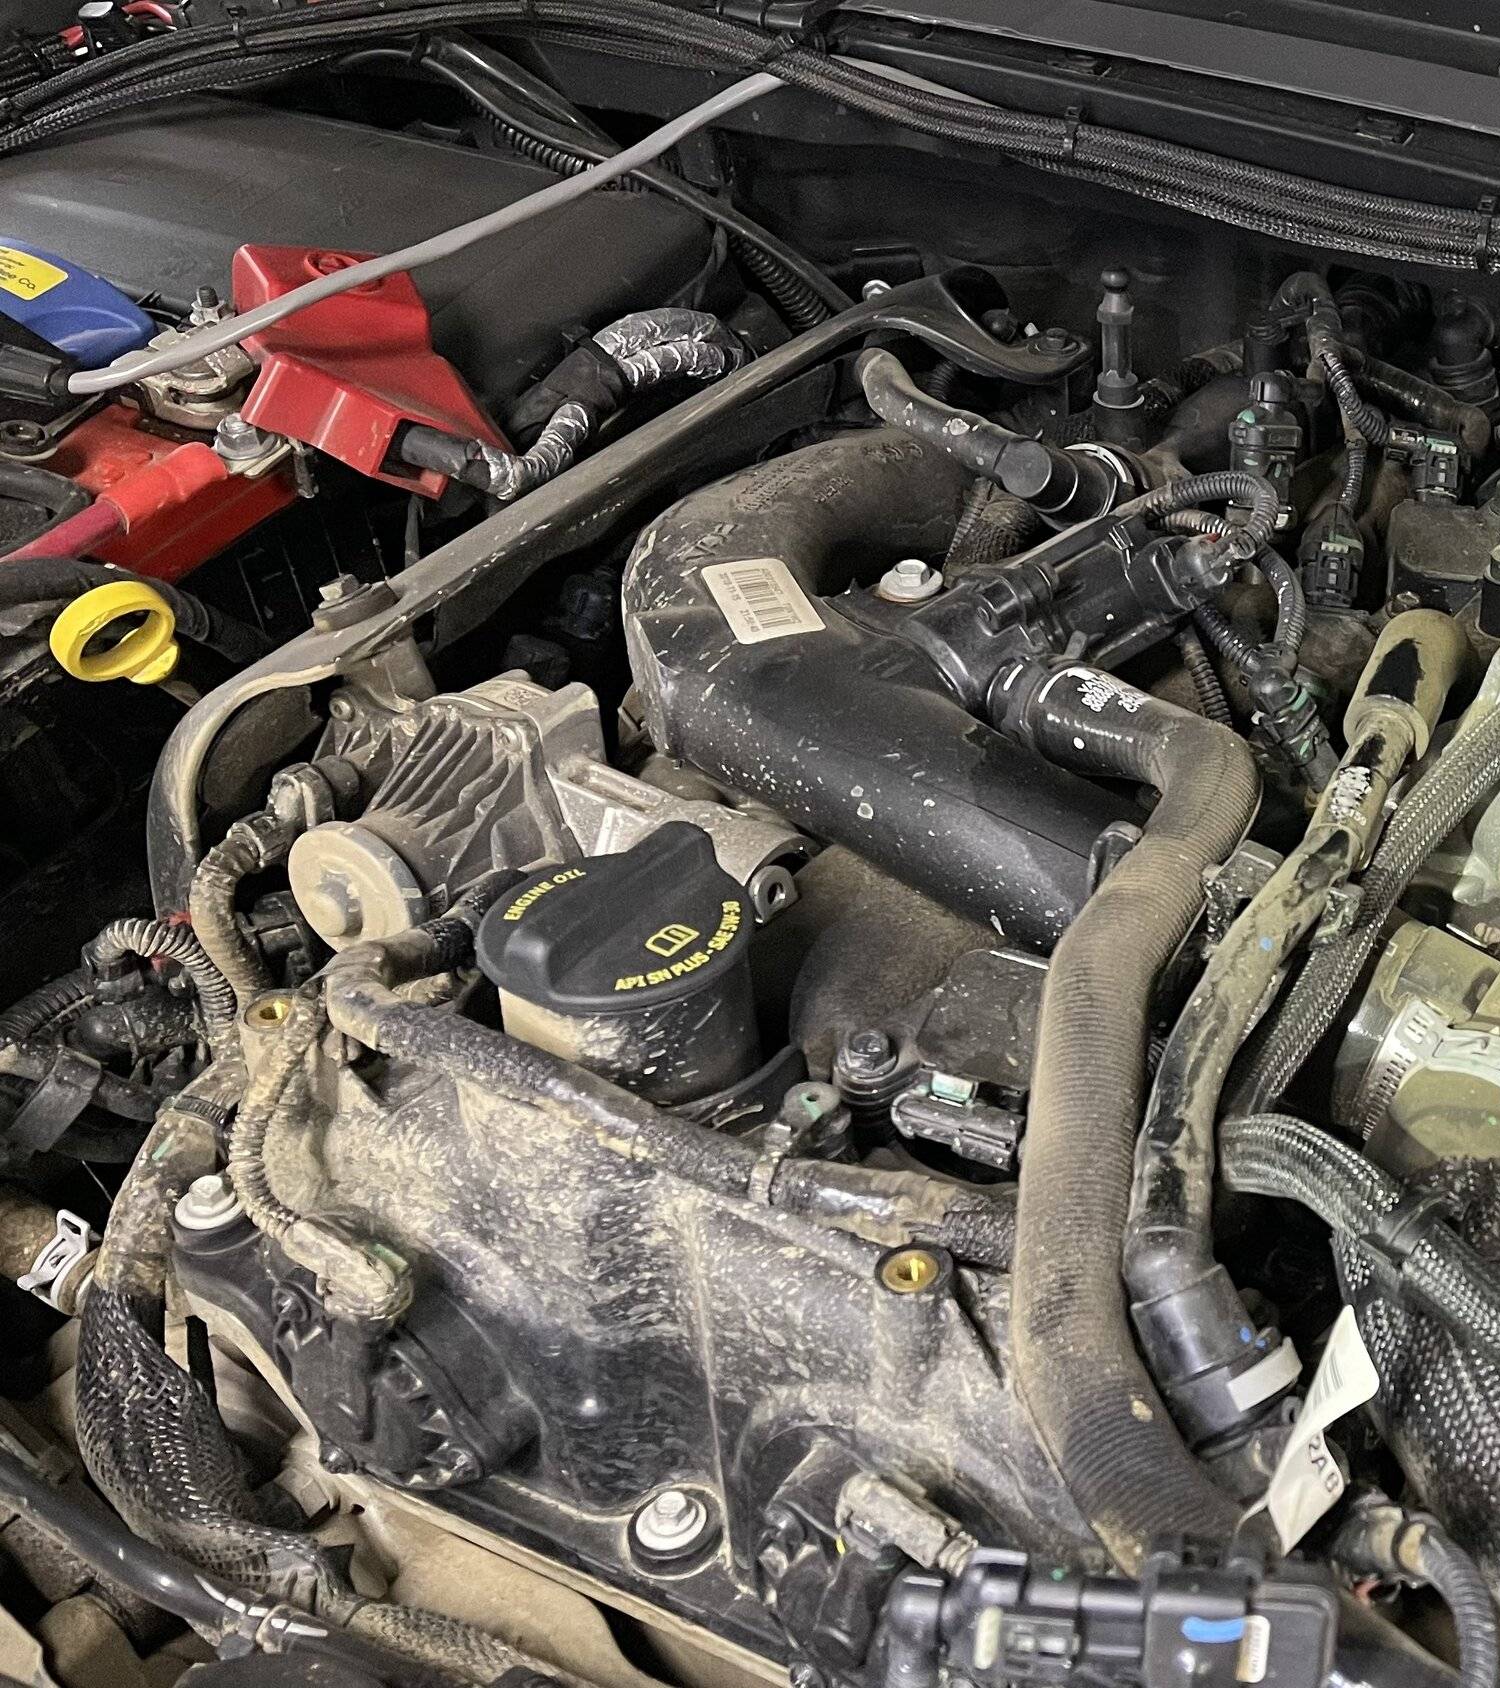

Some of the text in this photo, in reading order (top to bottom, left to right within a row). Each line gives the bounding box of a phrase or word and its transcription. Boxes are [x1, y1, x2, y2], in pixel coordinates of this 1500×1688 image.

[503, 868, 587, 920] ENGINE OIL
[720, 900, 741, 932] 5W-30
[707, 930, 735, 951] SAE
[670, 951, 711, 977] PLUS
[614, 975, 647, 991] API
[646, 968, 673, 985] SN
